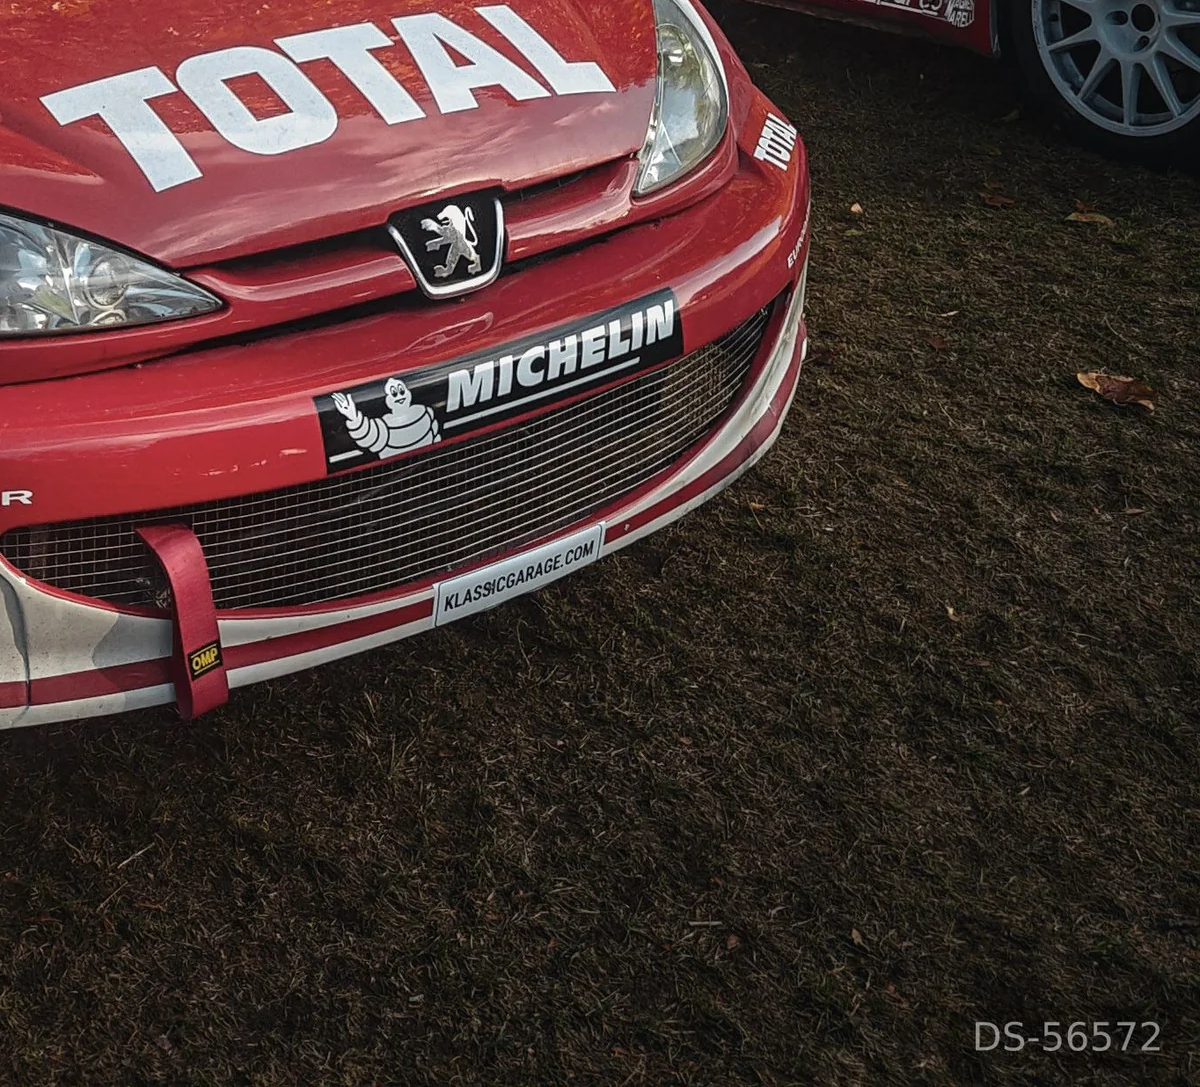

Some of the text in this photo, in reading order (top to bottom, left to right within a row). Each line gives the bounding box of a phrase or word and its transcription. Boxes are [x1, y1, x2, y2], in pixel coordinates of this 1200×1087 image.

[39, 4, 617, 193] TOTAL
[753, 112, 798, 172] TOTAL
[445, 299, 675, 413] MICHELIN
[443, 539, 596, 612] KLASSICGARAGE.COM
[192, 647, 219, 671] OMP
